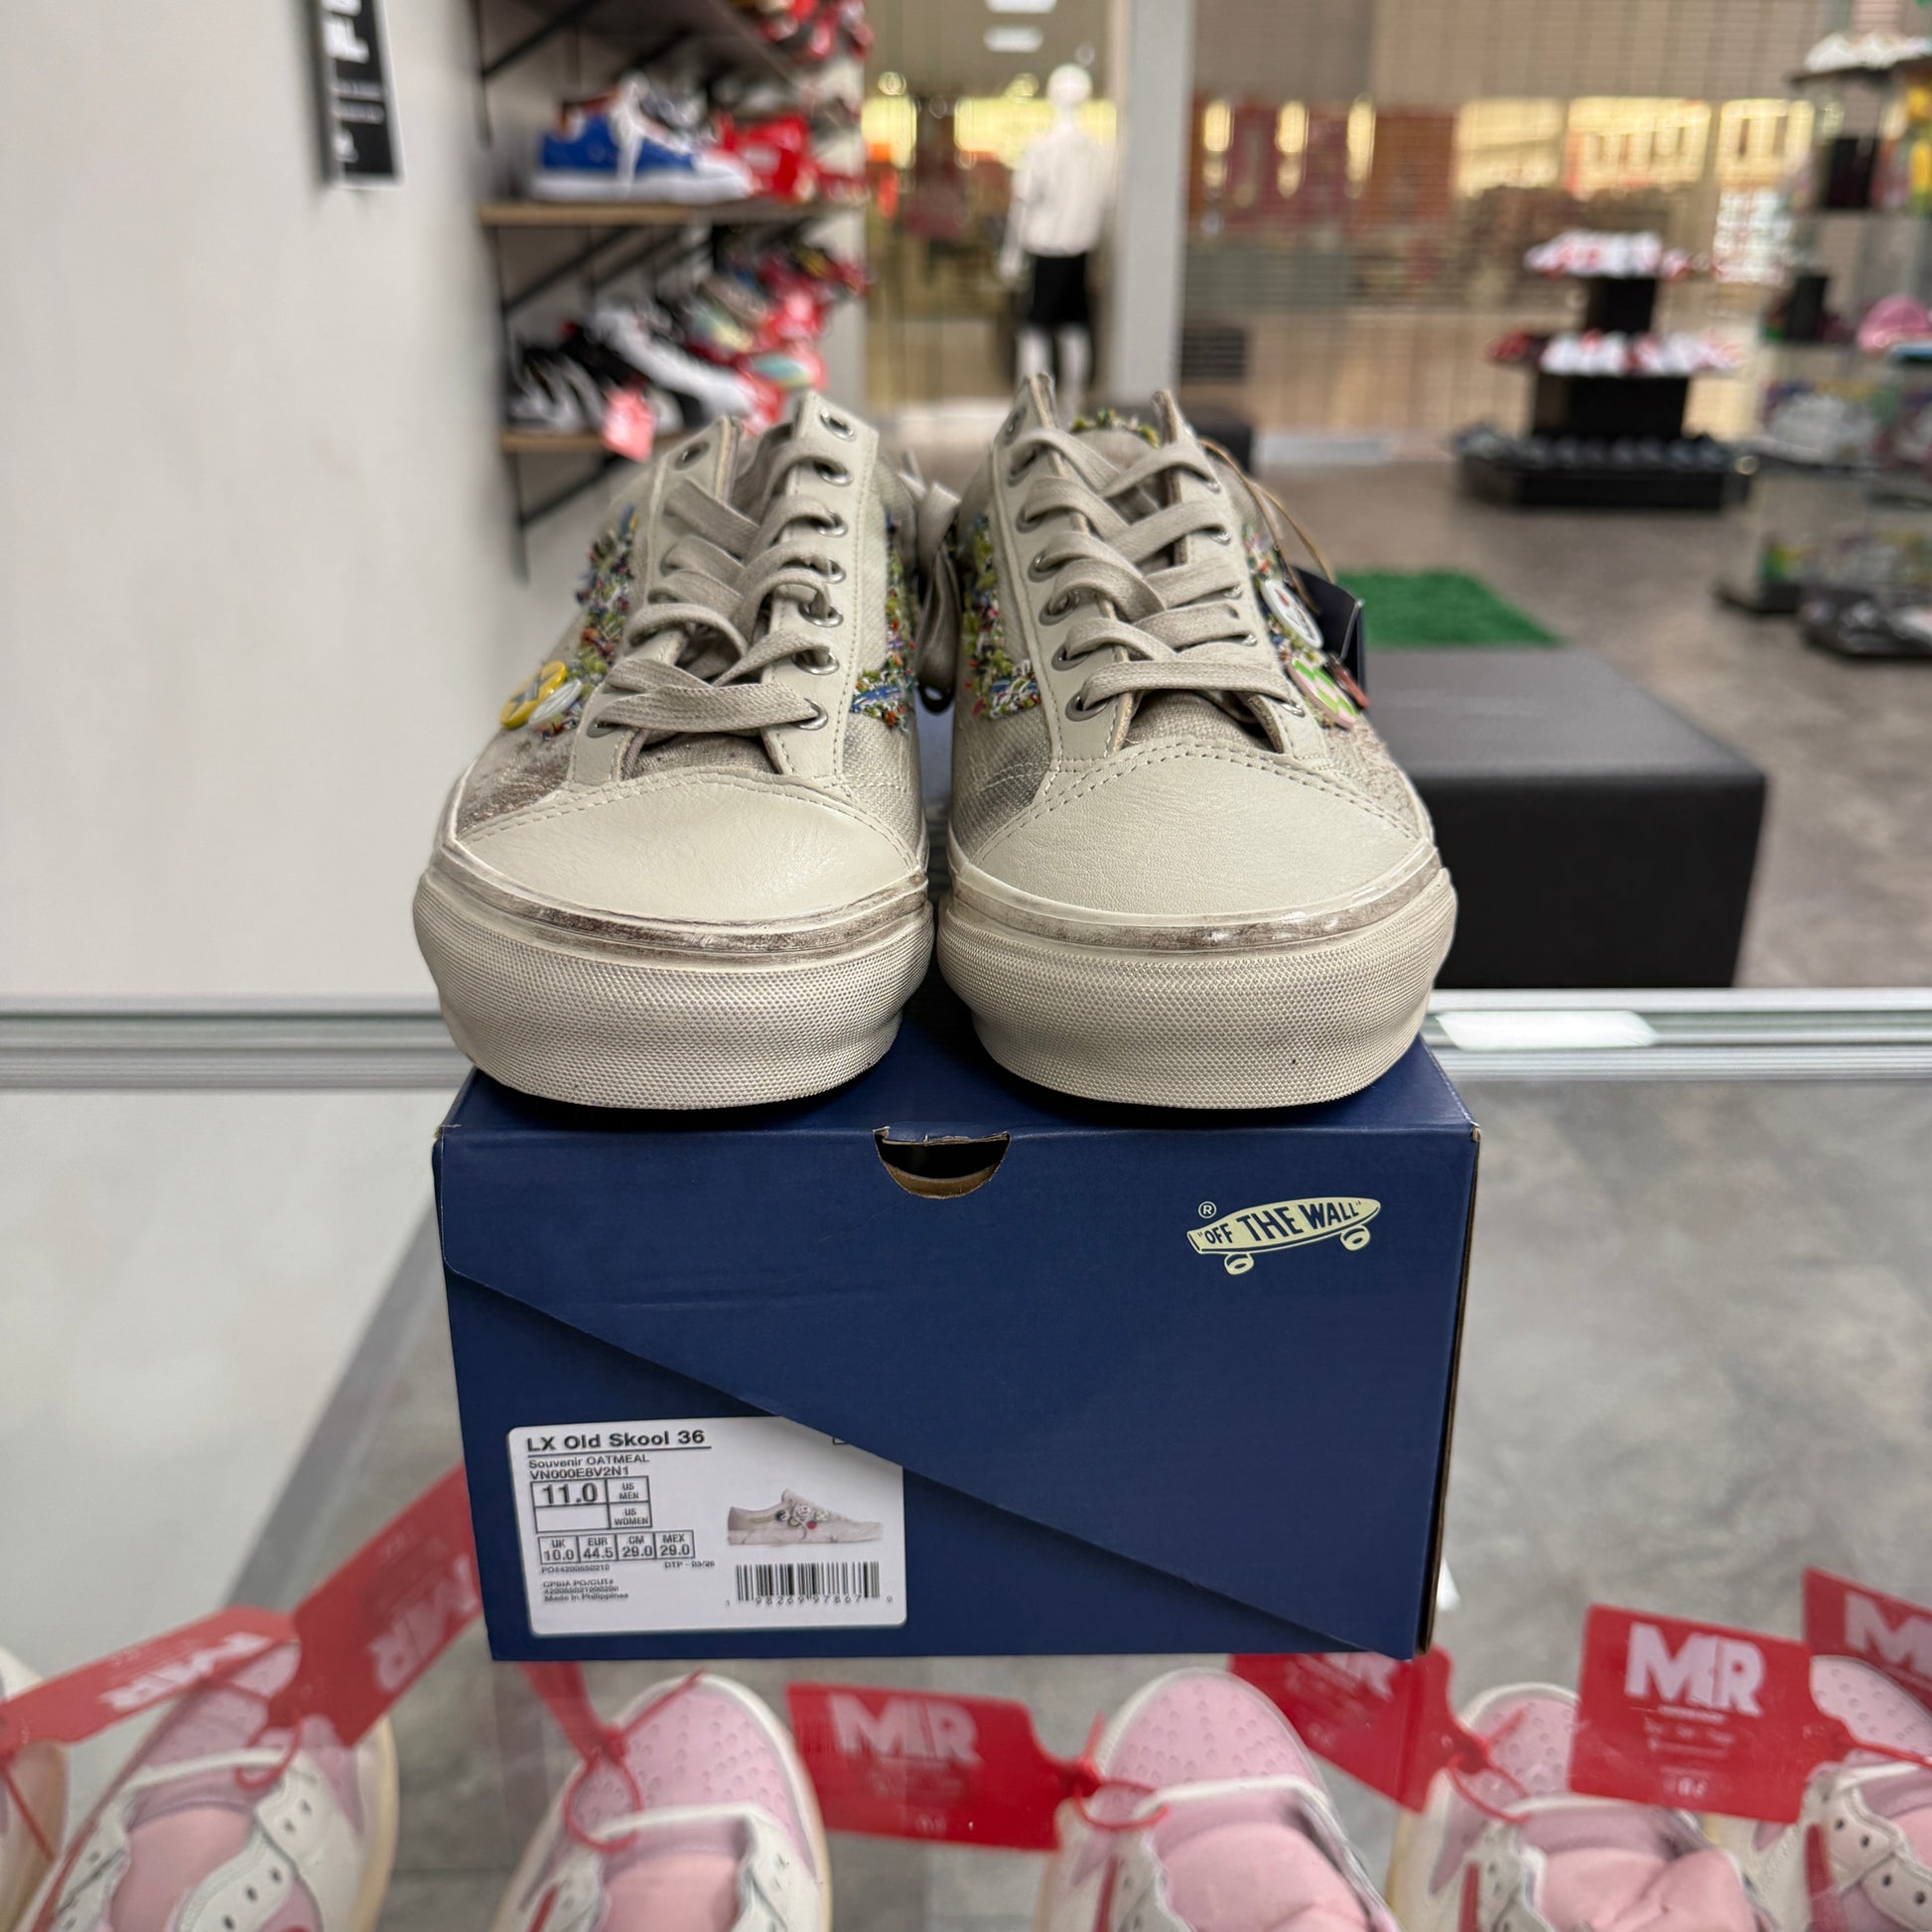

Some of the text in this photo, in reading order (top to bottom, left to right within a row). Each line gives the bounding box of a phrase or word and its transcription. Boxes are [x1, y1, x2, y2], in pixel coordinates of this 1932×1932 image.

[1236, 1206, 1304, 1242] THE
[527, 1430, 705, 1451] LX Old Skool 36
[528, 1453, 650, 1468] Souvenir OATMEAL
[529, 1465, 629, 1480] VN000E8V2N1
[542, 1482, 598, 1504] 11.0
[621, 1482, 634, 1491] US
[620, 1491, 639, 1500] MEN
[614, 1516, 649, 1526] WOMEN
[551, 1539, 566, 1549] UK
[588, 1537, 609, 1547] EUR
[628, 1535, 645, 1545] CM
[662, 1534, 685, 1543] MEX
[543, 1549, 575, 1562] 10.0
[583, 1547, 614, 1560] 44.5
[621, 1545, 653, 1559] 29.0
[660, 1544, 690, 1557] 29.0
[544, 1593, 569, 1602] Made
[582, 1591, 629, 1602] Philippines
[1845, 1591, 1932, 1680] M
[1624, 1620, 1765, 1717] MR
[827, 1692, 980, 1764] MR
